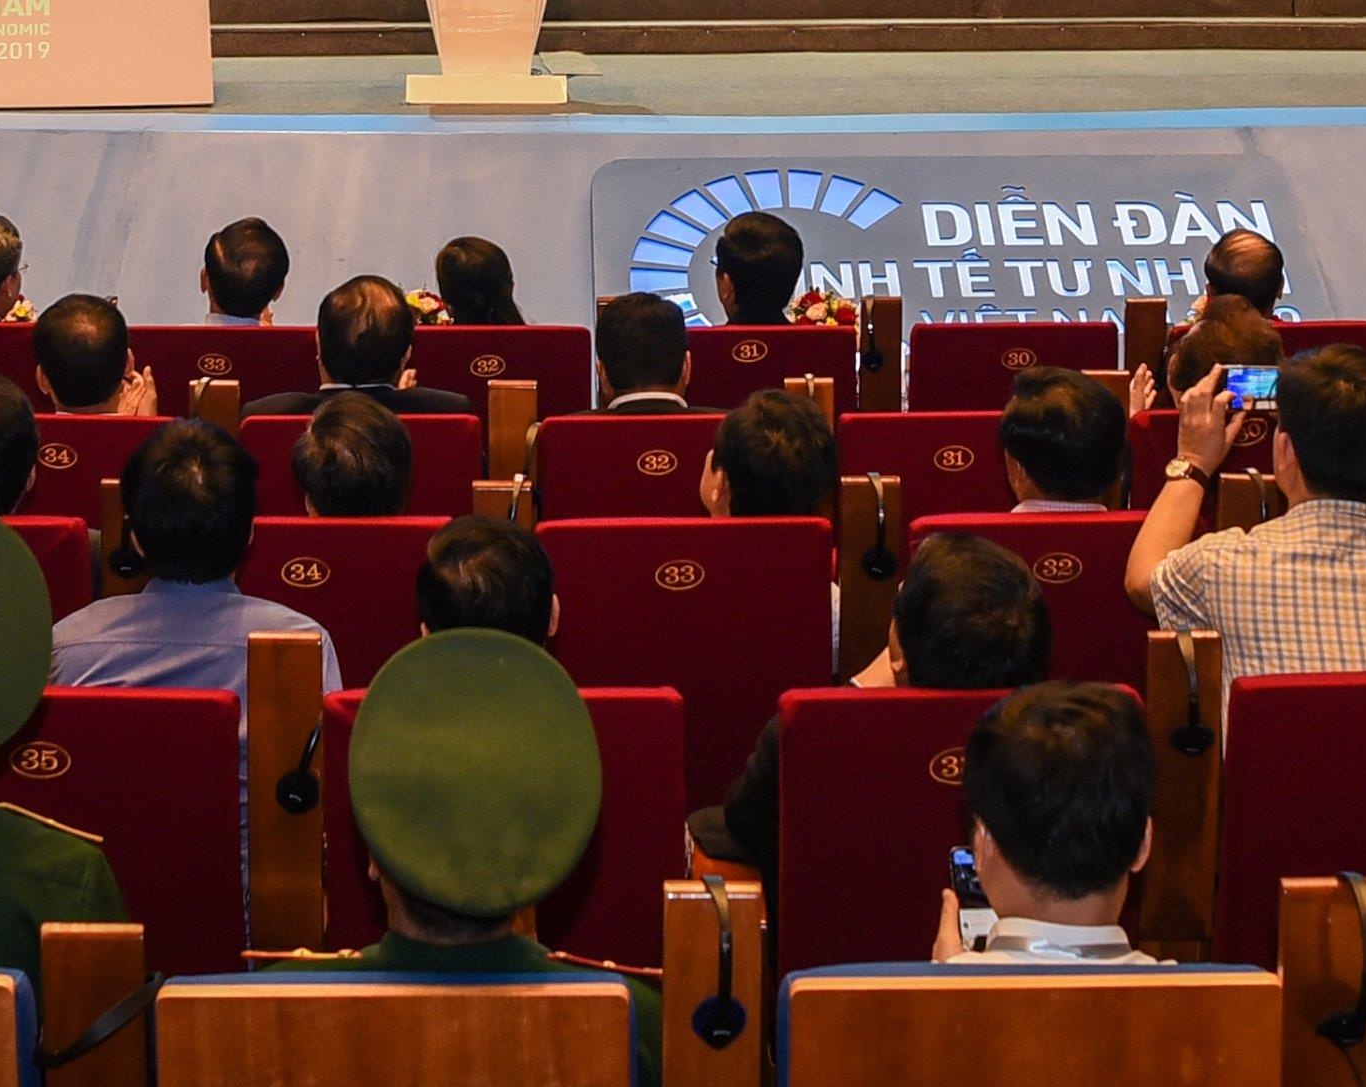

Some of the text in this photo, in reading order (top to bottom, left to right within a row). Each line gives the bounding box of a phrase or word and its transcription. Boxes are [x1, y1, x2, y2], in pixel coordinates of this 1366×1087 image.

[920, 185, 1275, 248] DIỄN ĐÀN
[914, 248, 1092, 297] TẾ TƯ
[740, 343, 762, 360] 31
[1007, 352, 1031, 367] 30
[205, 357, 226, 372] 33
[477, 358, 501, 374] 32
[46, 448, 71, 465] 34
[644, 453, 669, 471] 32
[941, 450, 966, 467] 31
[289, 562, 322, 583] 34
[664, 565, 696, 584] 33
[1042, 558, 1075, 578] 32
[22, 749, 60, 772] 35
